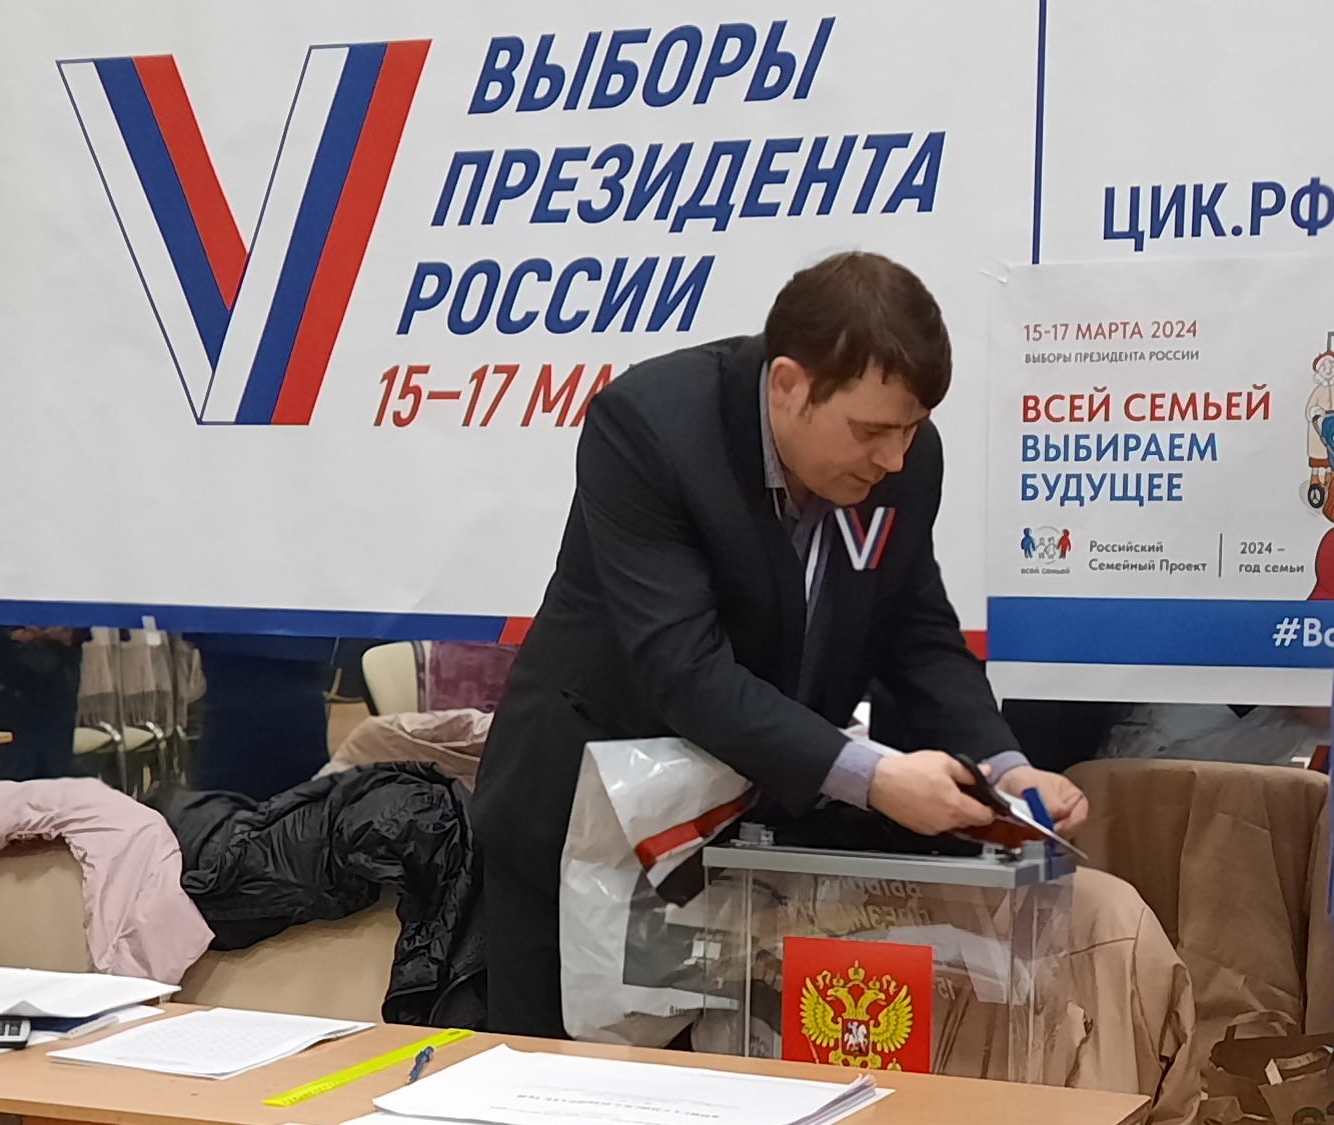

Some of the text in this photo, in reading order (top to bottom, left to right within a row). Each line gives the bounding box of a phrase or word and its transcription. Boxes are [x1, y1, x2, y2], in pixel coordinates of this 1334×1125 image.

[468, 16, 835, 115] ВЫБОРЫ
[430, 131, 946, 234] ПРЕЗИДЕНТА
[396, 255, 715, 336] РОССИИ
[1023, 319, 1198, 342] 15-17 МАРТА 2024
[1024, 350, 1200, 364] ВЫБОРЫ ПРЕЗИДЕНТА РОССИИ
[374, 363, 613, 428] 15–17 МА
[1022, 383, 1271, 423] ВСЕЙ СЕМЬЕЙ
[1021, 432, 1218, 463] ВЫБИРАЕМ
[1021, 472, 1183, 508] БУДУЩЕЕ
[1089, 539, 1164, 553] Российский
[1240, 541, 1273, 555] 2024
[1088, 558, 1208, 574] Семейный Проект
[1238, 563, 1305, 574] год семьи
